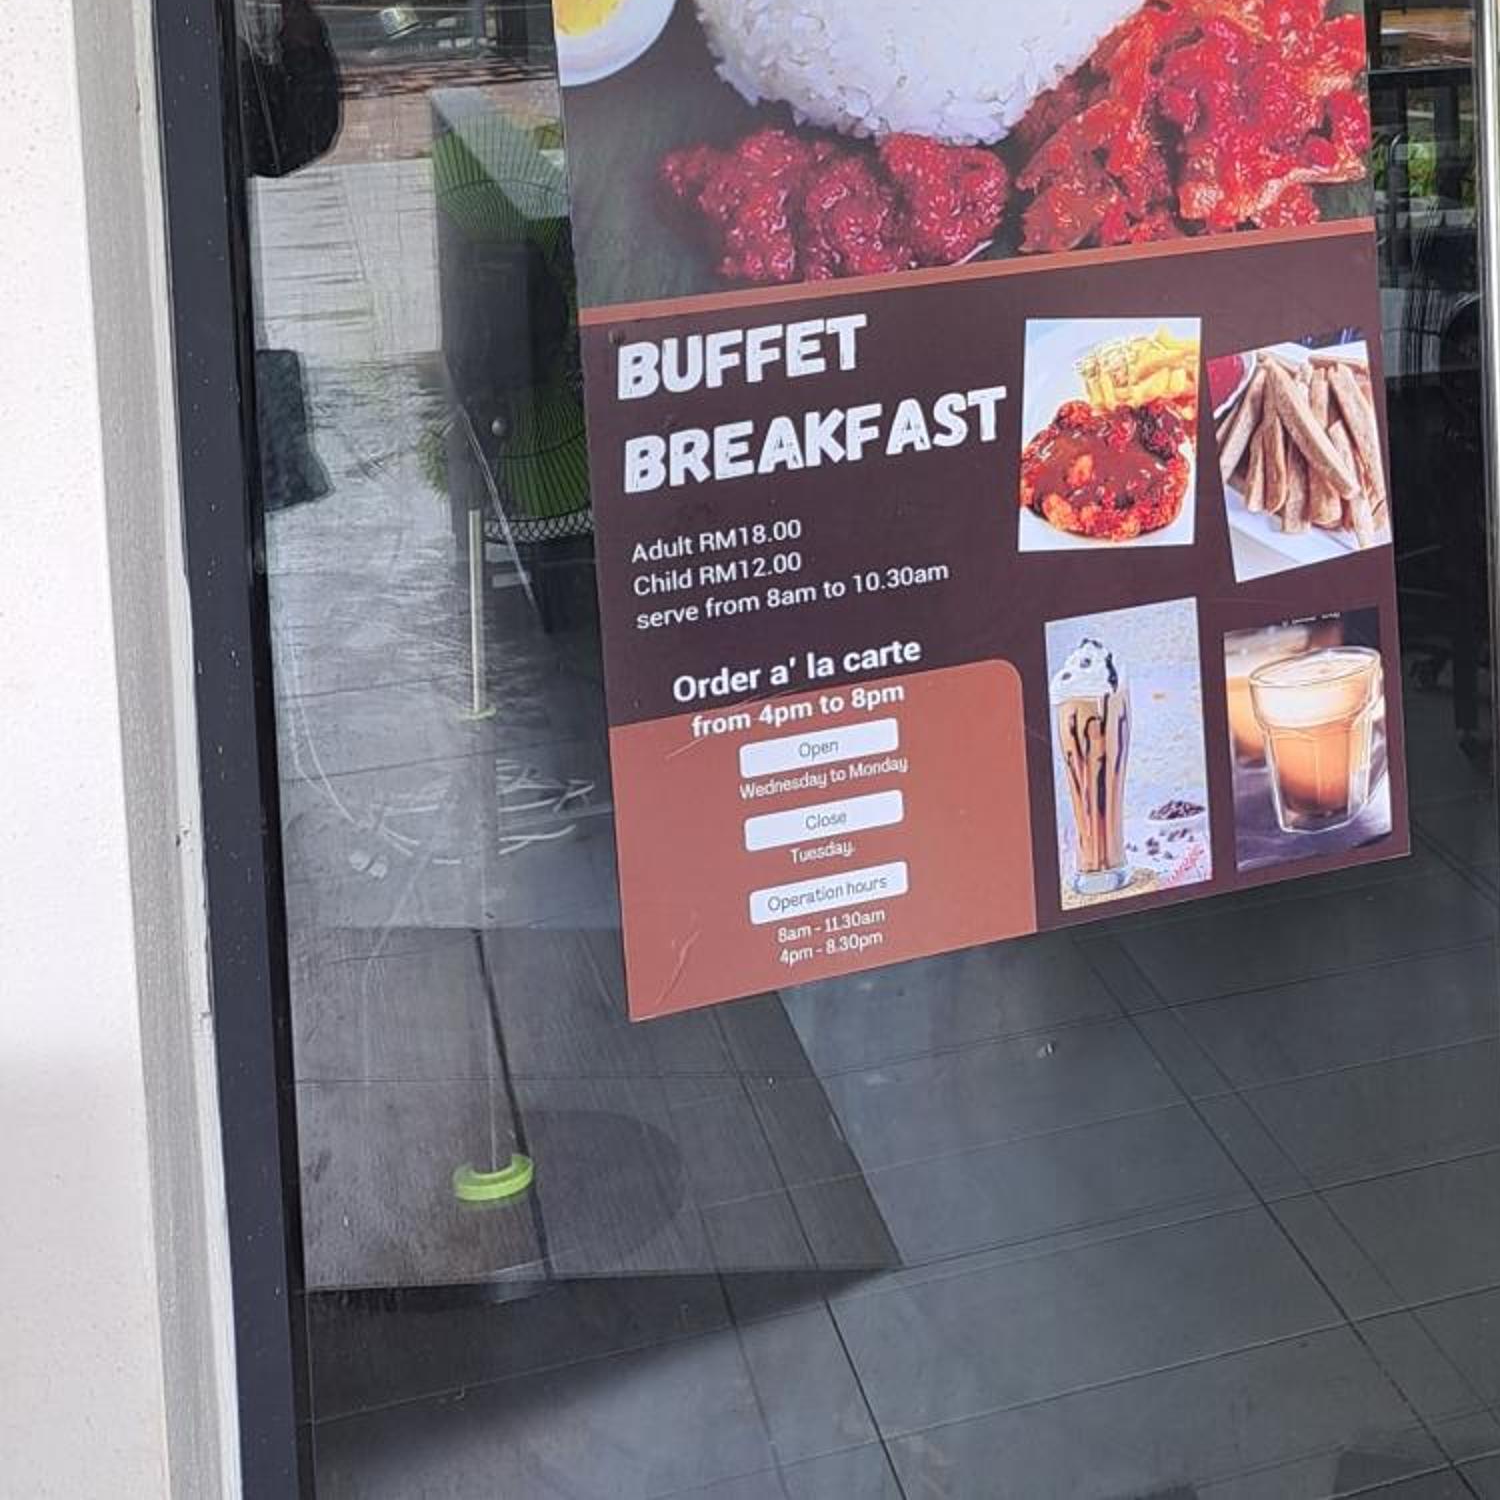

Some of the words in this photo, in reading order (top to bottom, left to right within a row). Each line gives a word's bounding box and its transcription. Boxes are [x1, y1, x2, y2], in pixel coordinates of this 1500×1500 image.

[617, 313, 868, 400] BUFFET
[624, 385, 1007, 494] BREAKFAST
[631, 536, 693, 564] Adult
[699, 518, 802, 553] RM18.00
[633, 571, 692, 597] Child
[699, 551, 802, 587] RM12.00
[636, 604, 699, 630] serve
[704, 594, 760, 619] from
[766, 585, 816, 608] 8am
[823, 580, 846, 601] to
[852, 562, 949, 593] 10.30am
[672, 667, 759, 703] Order
[769, 656, 797, 687] a'
[806, 652, 835, 680] la
[843, 640, 922, 674] carte
[691, 713, 751, 738] from
[758, 702, 813, 729] 4pm
[819, 694, 845, 714] to
[851, 683, 905, 713] 8pm
[799, 739, 839, 760] Open
[740, 774, 828, 800] Wednesday
[831, 769, 847, 783] to
[850, 756, 908, 779] Monday
[805, 811, 848, 831] Close
[767, 888, 844, 913] Operation
[847, 876, 888, 898] hours
[778, 925, 813, 943] 8am
[780, 947, 813, 968] 4pm
[826, 931, 884, 955] 8.30pm
